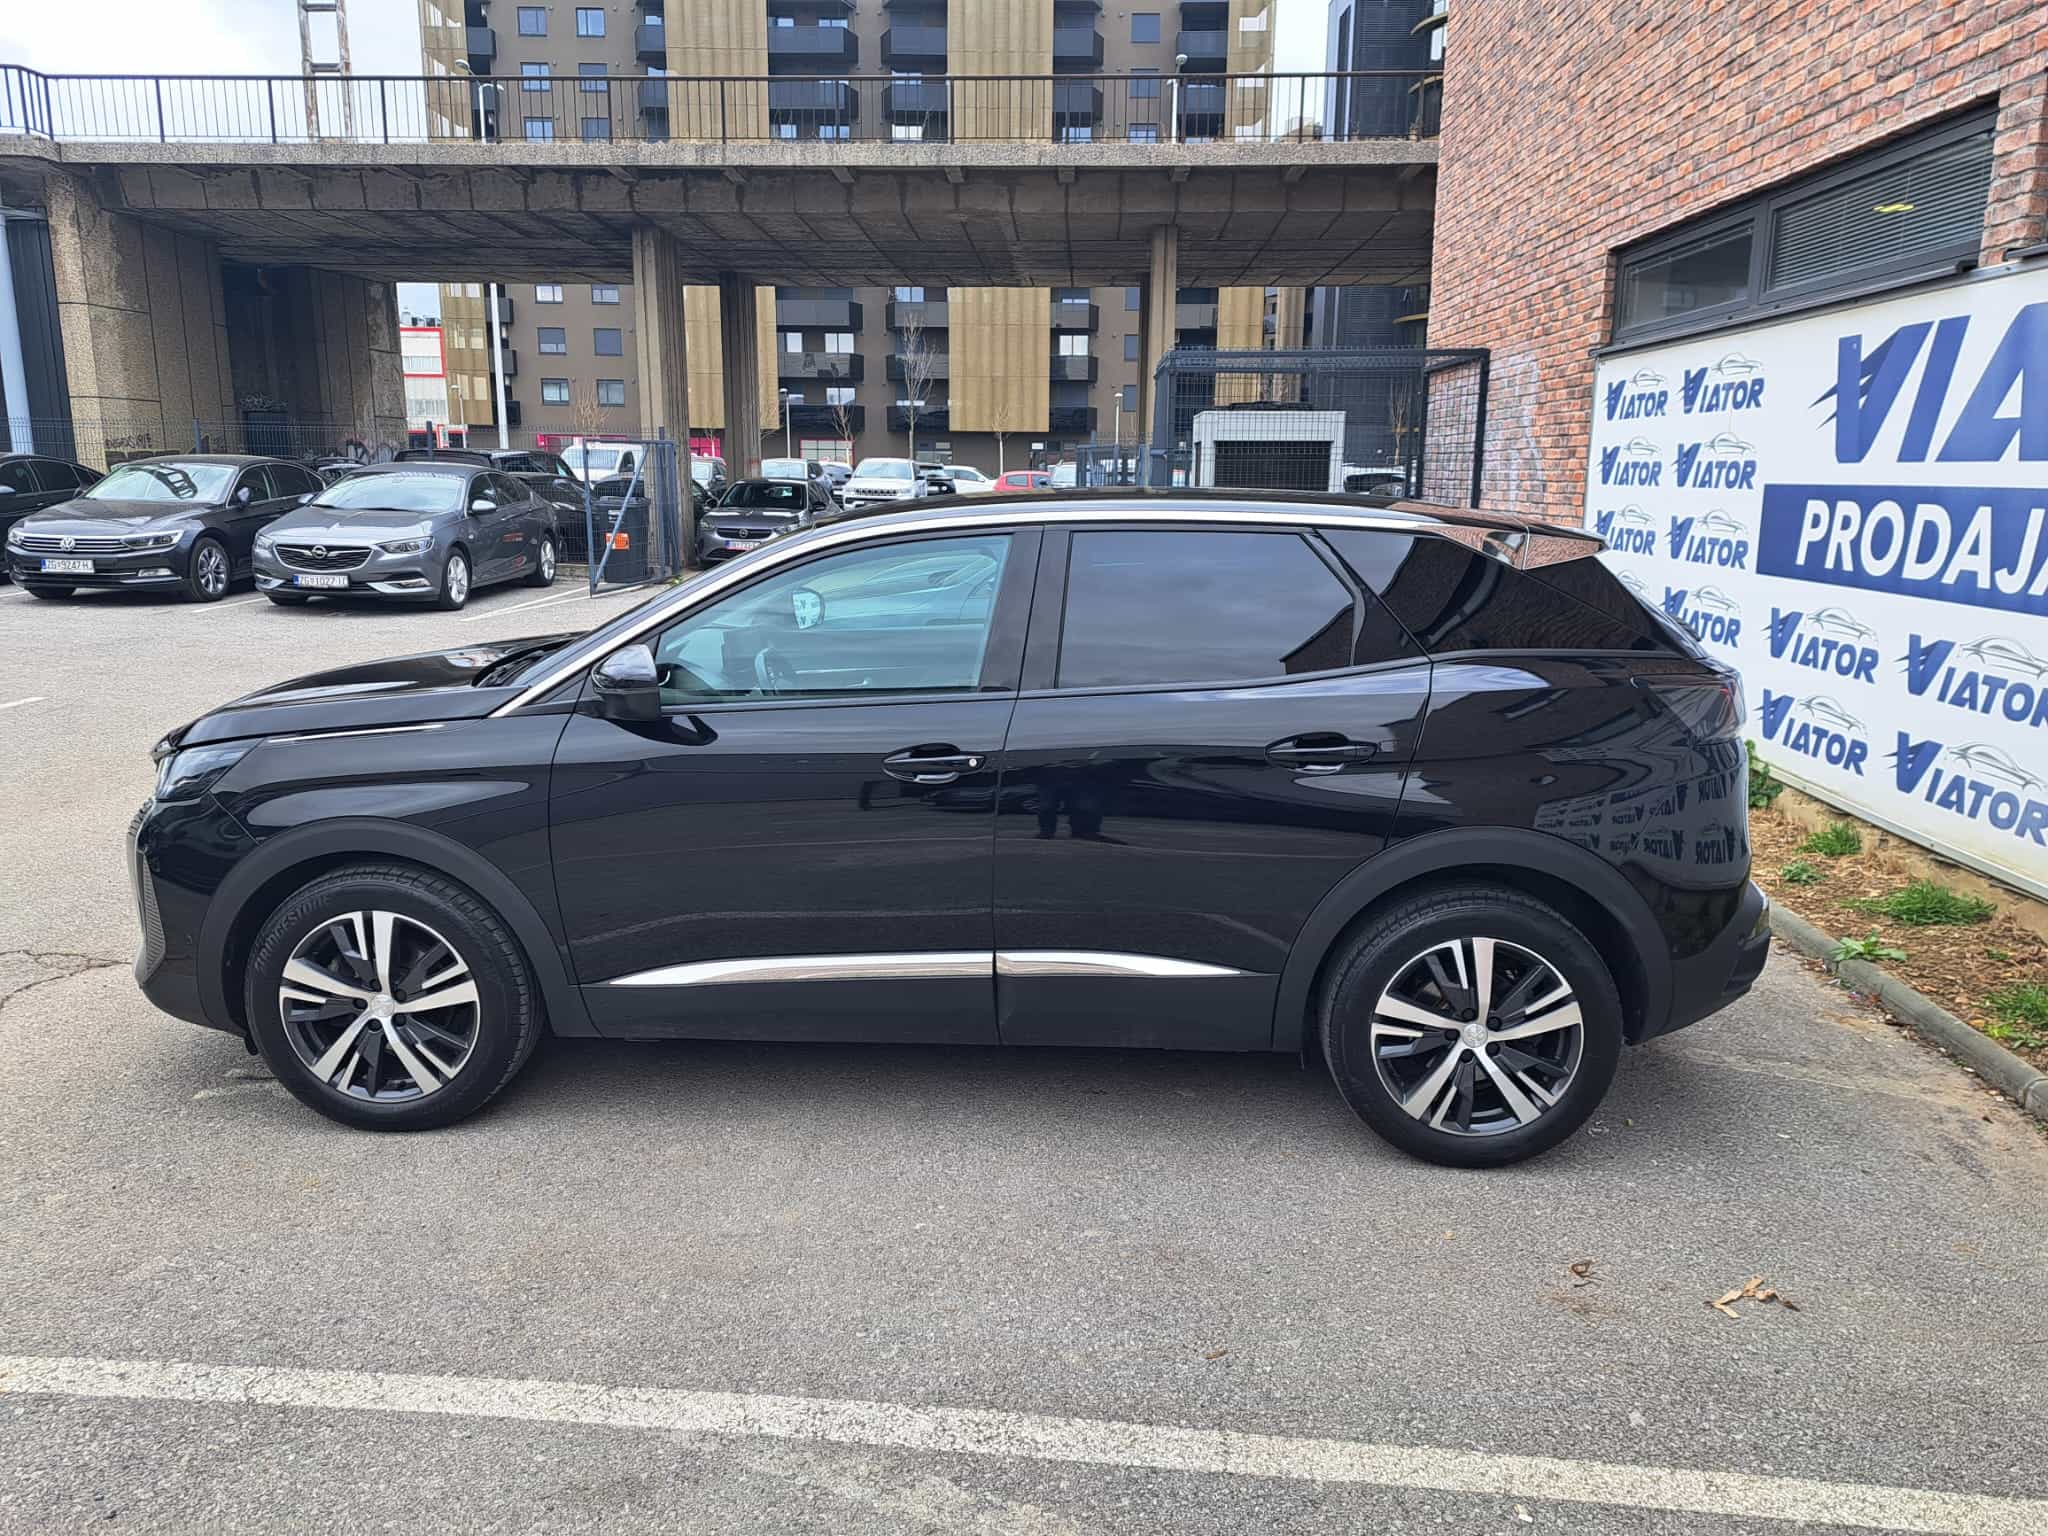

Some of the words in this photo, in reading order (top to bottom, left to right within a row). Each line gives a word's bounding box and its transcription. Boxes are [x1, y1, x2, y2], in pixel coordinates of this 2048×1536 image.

[1604, 380, 1668, 421] VIATOR
[1678, 367, 1765, 414] VIATOR
[1597, 446, 1662, 487] VIATOR
[1672, 442, 1757, 489] VIATOR
[1594, 510, 1656, 555] VIATOR
[1664, 515, 1749, 569] VIATOR
[1761, 607, 1879, 684] VIATOR
[1754, 688, 1868, 776] VIATOR
[1883, 731, 2048, 847] VIATOR
